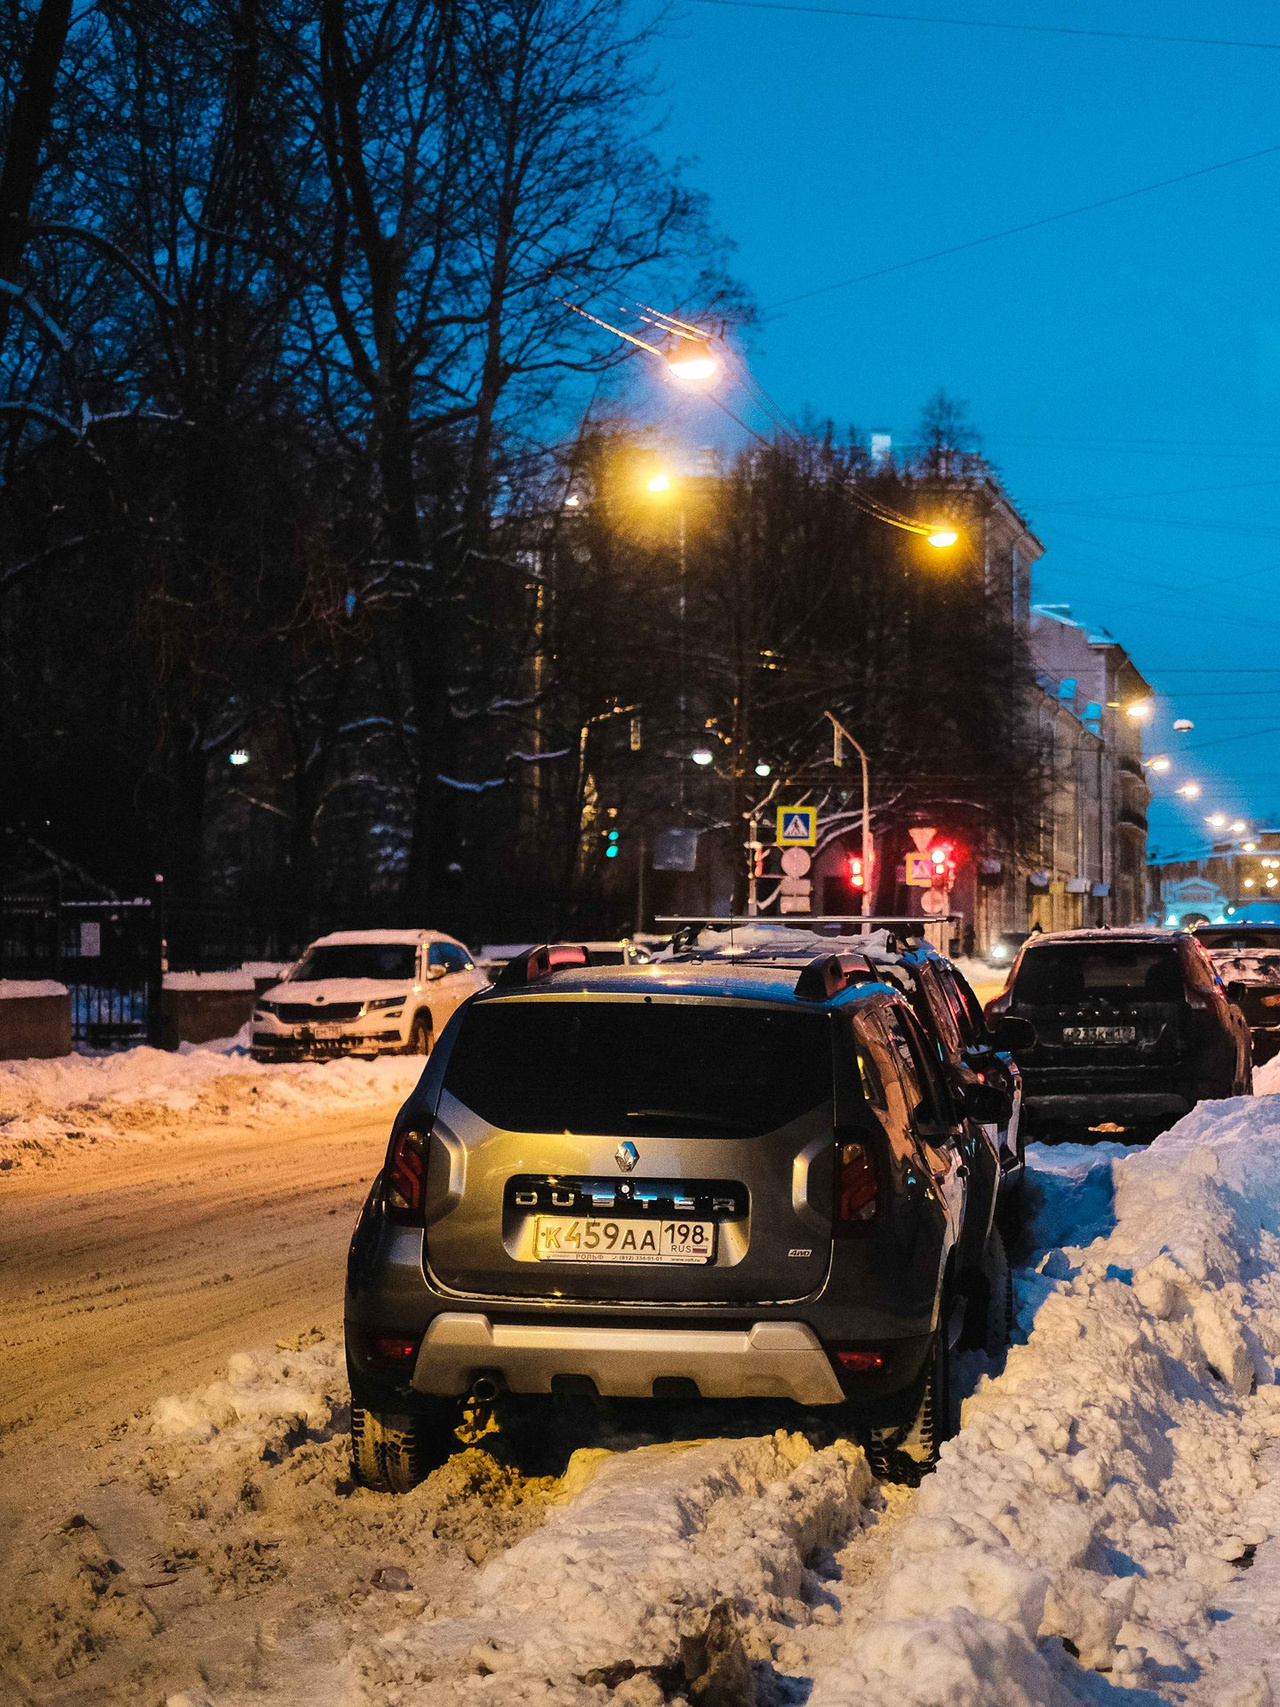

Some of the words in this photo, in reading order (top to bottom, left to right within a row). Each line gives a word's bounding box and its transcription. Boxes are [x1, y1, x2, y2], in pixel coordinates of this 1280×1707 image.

[515, 1191, 735, 1212] DUSTER
[545, 1220, 656, 1251] К459АА
[664, 1223, 704, 1245] 198
[671, 1245, 692, 1254] RUS
[790, 1249, 811, 1257] 4WD
